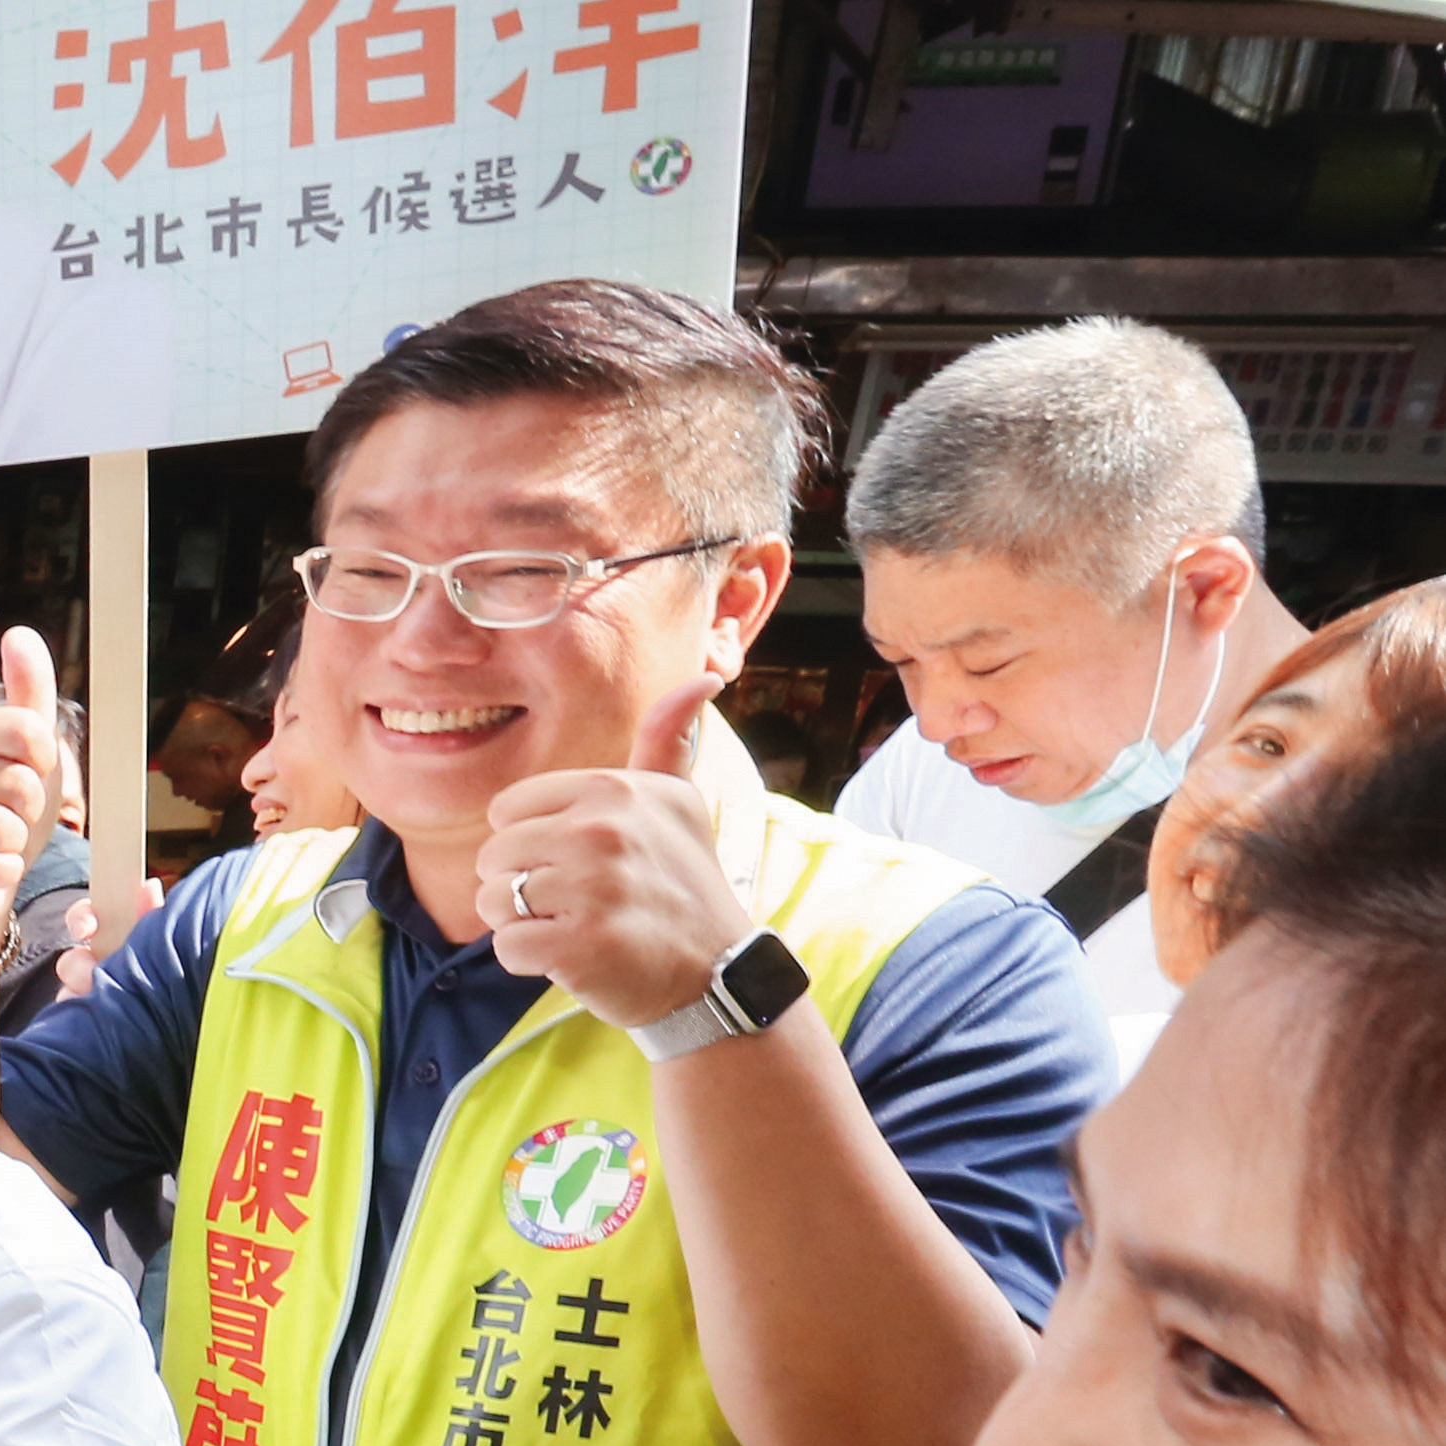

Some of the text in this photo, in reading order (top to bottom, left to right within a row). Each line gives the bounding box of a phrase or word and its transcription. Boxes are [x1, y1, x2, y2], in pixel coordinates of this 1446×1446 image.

[51, 152, 607, 281] 台北市長候選人
